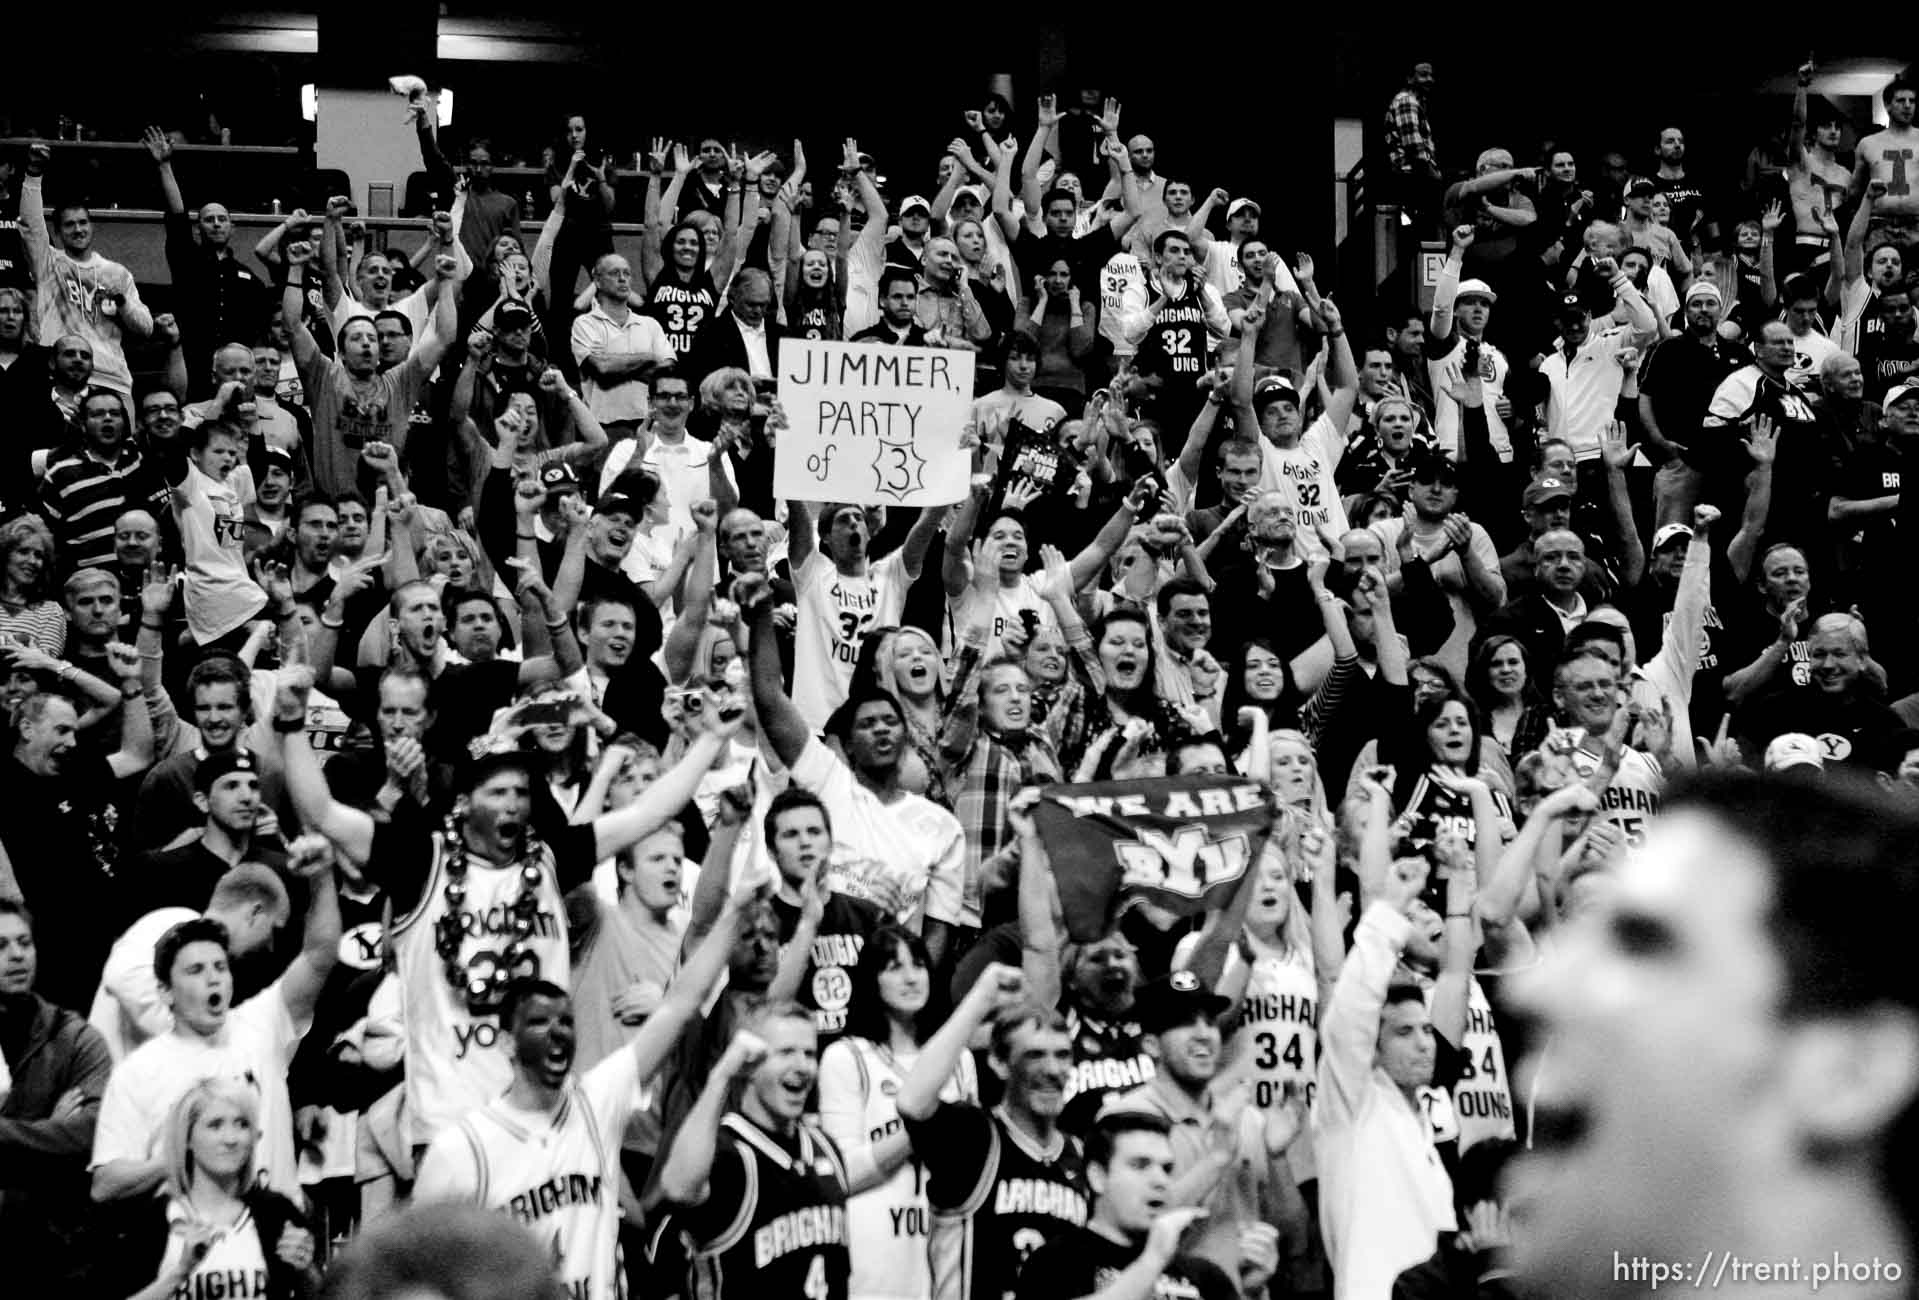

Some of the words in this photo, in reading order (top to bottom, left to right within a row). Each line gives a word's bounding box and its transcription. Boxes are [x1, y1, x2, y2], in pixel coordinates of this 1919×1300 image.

[1107, 277, 1128, 294] 32
[667, 303, 704, 332] 32
[1161, 328, 1192, 355] 32
[790, 350, 960, 394] JIMMER,
[818, 400, 923, 438] PARTY
[807, 444, 837, 482] of
[887, 447, 910, 490] 3
[1297, 483, 1321, 506] 32
[1164, 783, 1265, 818] ARE
[1113, 822, 1251, 898] BYU
[1255, 1032, 1304, 1071] 34
